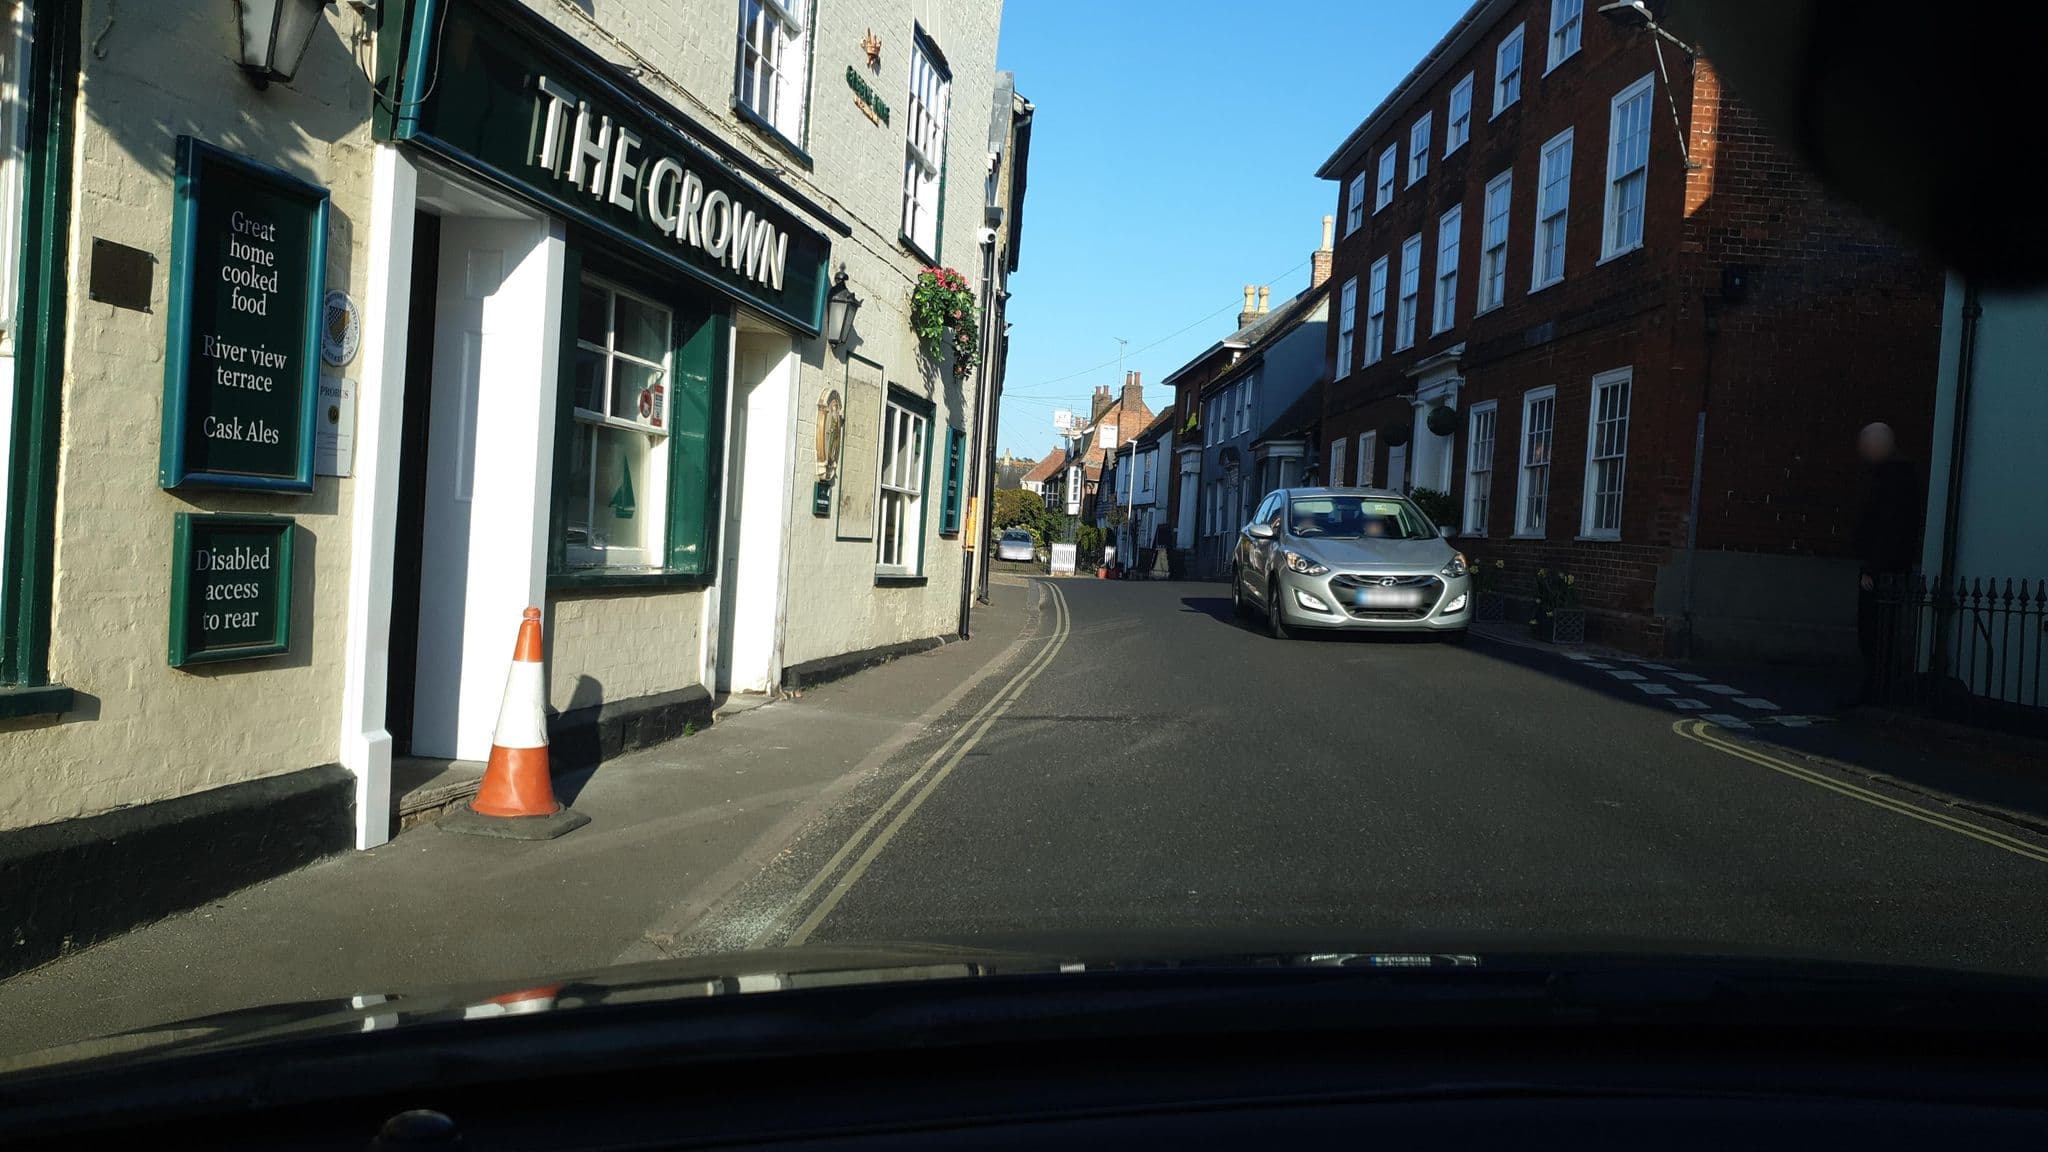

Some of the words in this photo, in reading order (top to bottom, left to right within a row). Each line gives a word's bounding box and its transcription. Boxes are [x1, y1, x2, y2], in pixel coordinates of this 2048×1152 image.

[537, 76, 641, 212] THE
[648, 157, 789, 291] CROWN
[231, 210, 276, 242] Great
[229, 233, 274, 267] home
[222, 264, 278, 293] cooked
[231, 286, 267, 316] food
[202, 335, 248, 363] River
[250, 344, 287, 370] view
[217, 365, 273, 392] terrace
[203, 416, 243, 440] Cask
[246, 420, 279, 444] Ales
[196, 547, 270, 571] Disabled
[205, 583, 259, 600] access
[203, 612, 220, 630] to
[223, 612, 259, 629] rear
